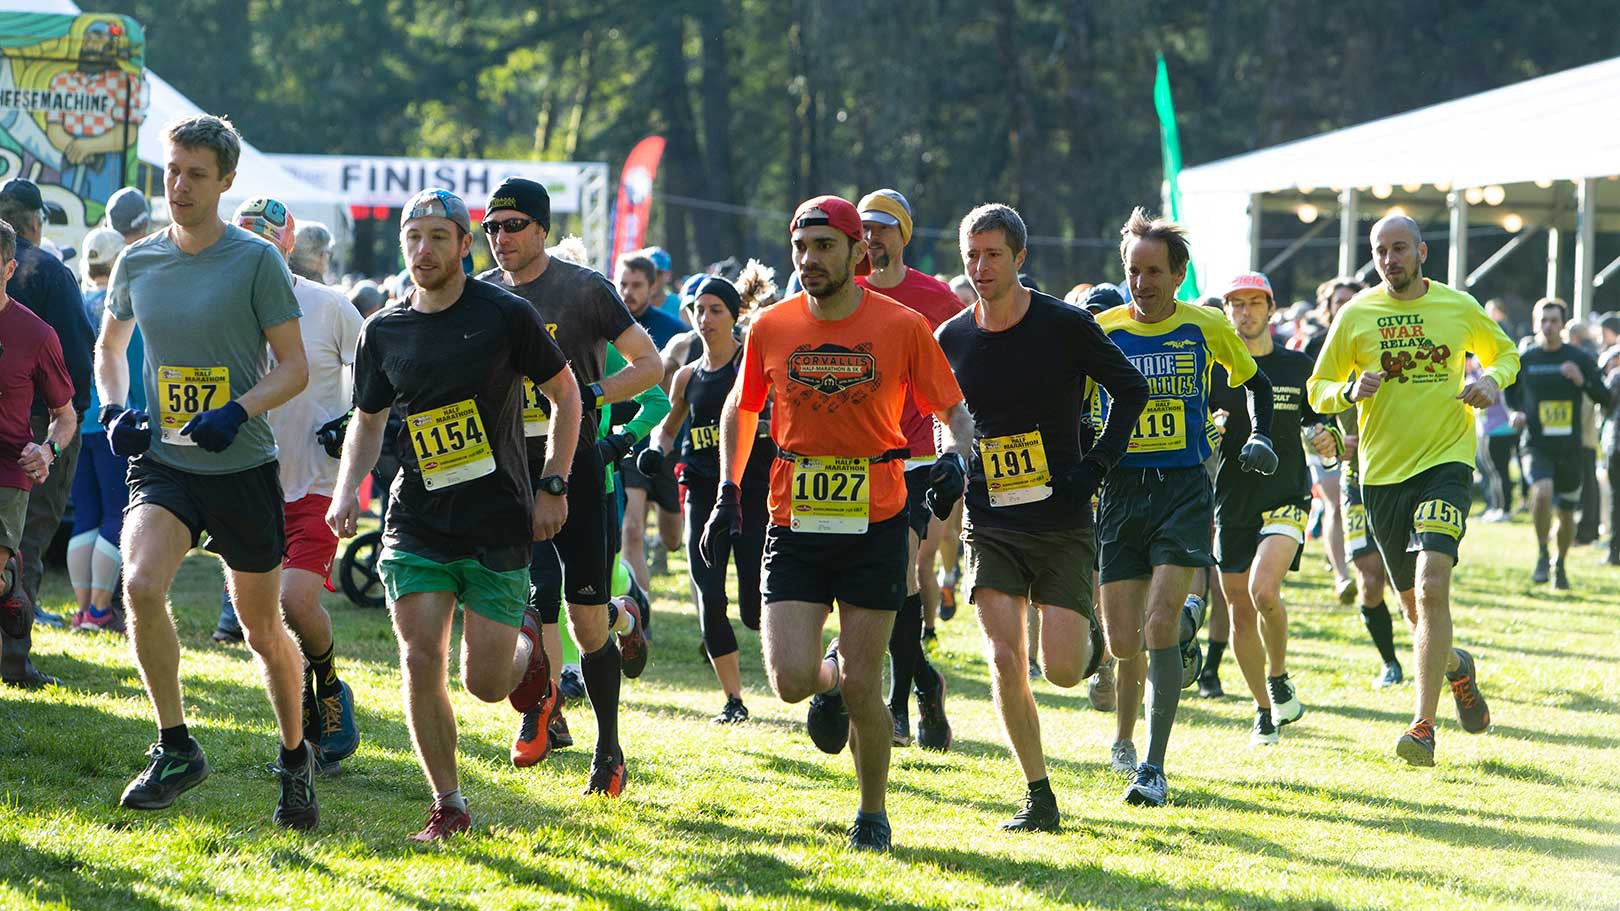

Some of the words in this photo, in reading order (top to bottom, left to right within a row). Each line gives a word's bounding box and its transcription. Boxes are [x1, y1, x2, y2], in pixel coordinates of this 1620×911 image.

[341, 164, 489, 194] FINISH
[1377, 314, 1423, 327] CIVIL
[1379, 325, 1424, 339] WAR
[1380, 337, 1425, 350] RELAY
[794, 356, 868, 366] CORVALLIS
[168, 384, 217, 413] 587
[436, 408, 474, 423] MARATHON
[443, 407, 460, 415] HALF
[1133, 413, 1176, 438] 119
[415, 416, 483, 459] 1154
[1003, 440, 1039, 449] MARATHON
[991, 449, 1036, 478] 191
[795, 472, 866, 502] 1027
[1416, 501, 1460, 528] 1151
